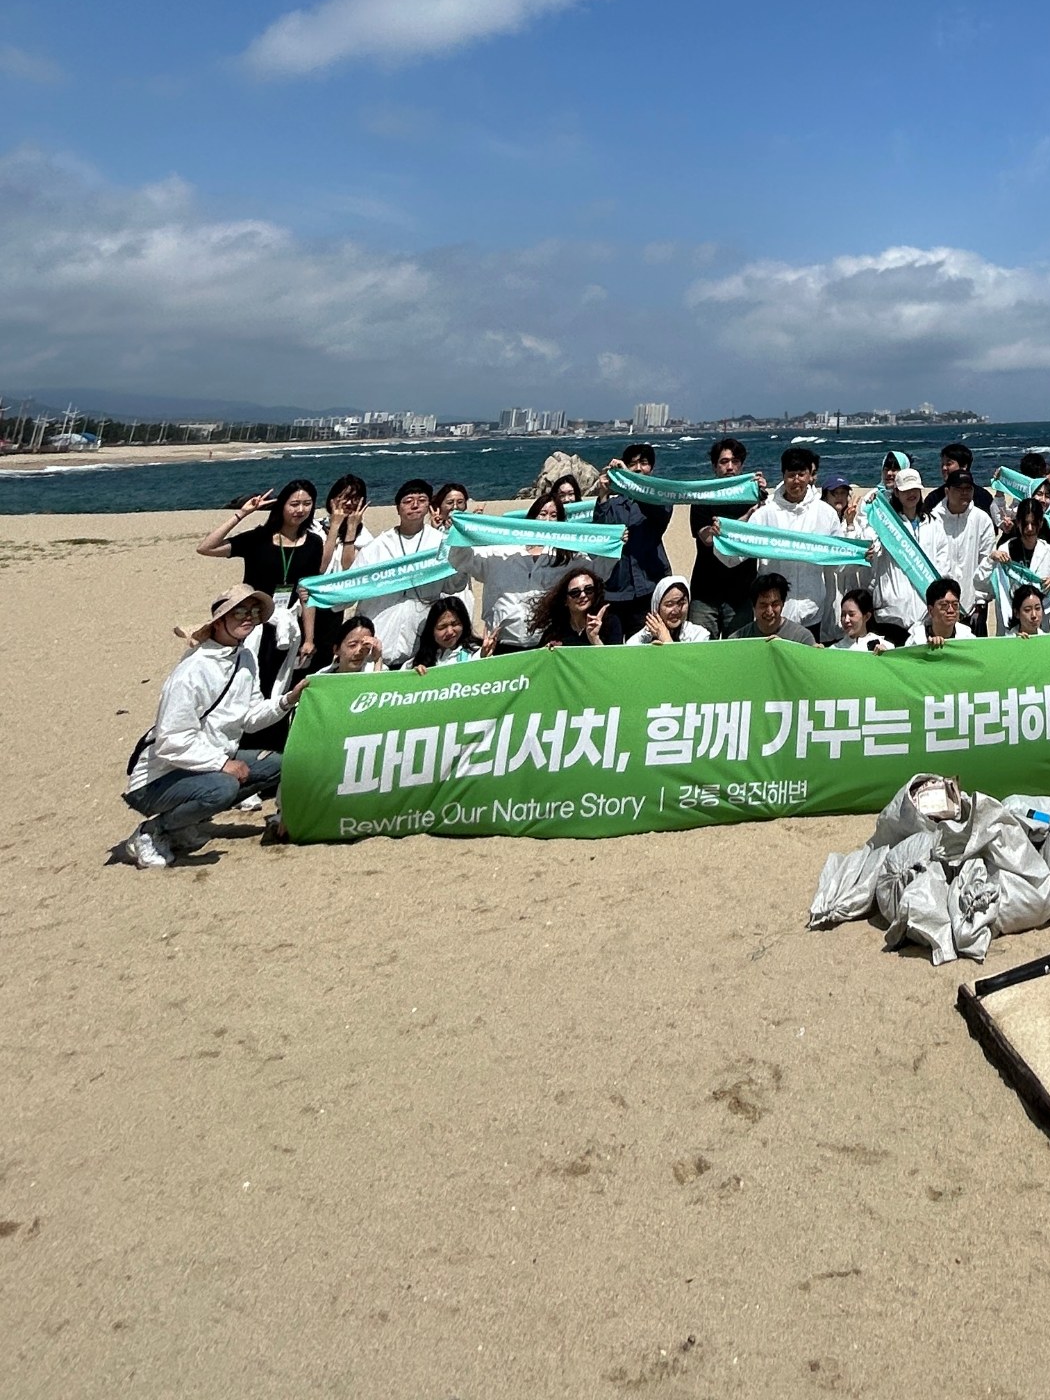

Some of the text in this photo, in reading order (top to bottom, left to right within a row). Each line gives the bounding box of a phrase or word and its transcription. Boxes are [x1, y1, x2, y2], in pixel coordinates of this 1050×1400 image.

[657, 489, 676, 500] OUR
[512, 529, 535, 538] OUR
[535, 531, 577, 542] NATURE
[578, 533, 611, 543] STORY
[770, 537, 791, 547] OUR
[792, 540, 829, 554] NATURE
[901, 539, 918, 558] OUR
[371, 569, 396, 582] OUR
[378, 674, 530, 708] PharmaResearch
[337, 706, 631, 795] 파마리서치,
[645, 702, 752, 766] 함께
[761, 697, 912, 759] 가꾸는
[339, 780, 808, 836] Rewrite Our Nature Story 강릉 영진해변
